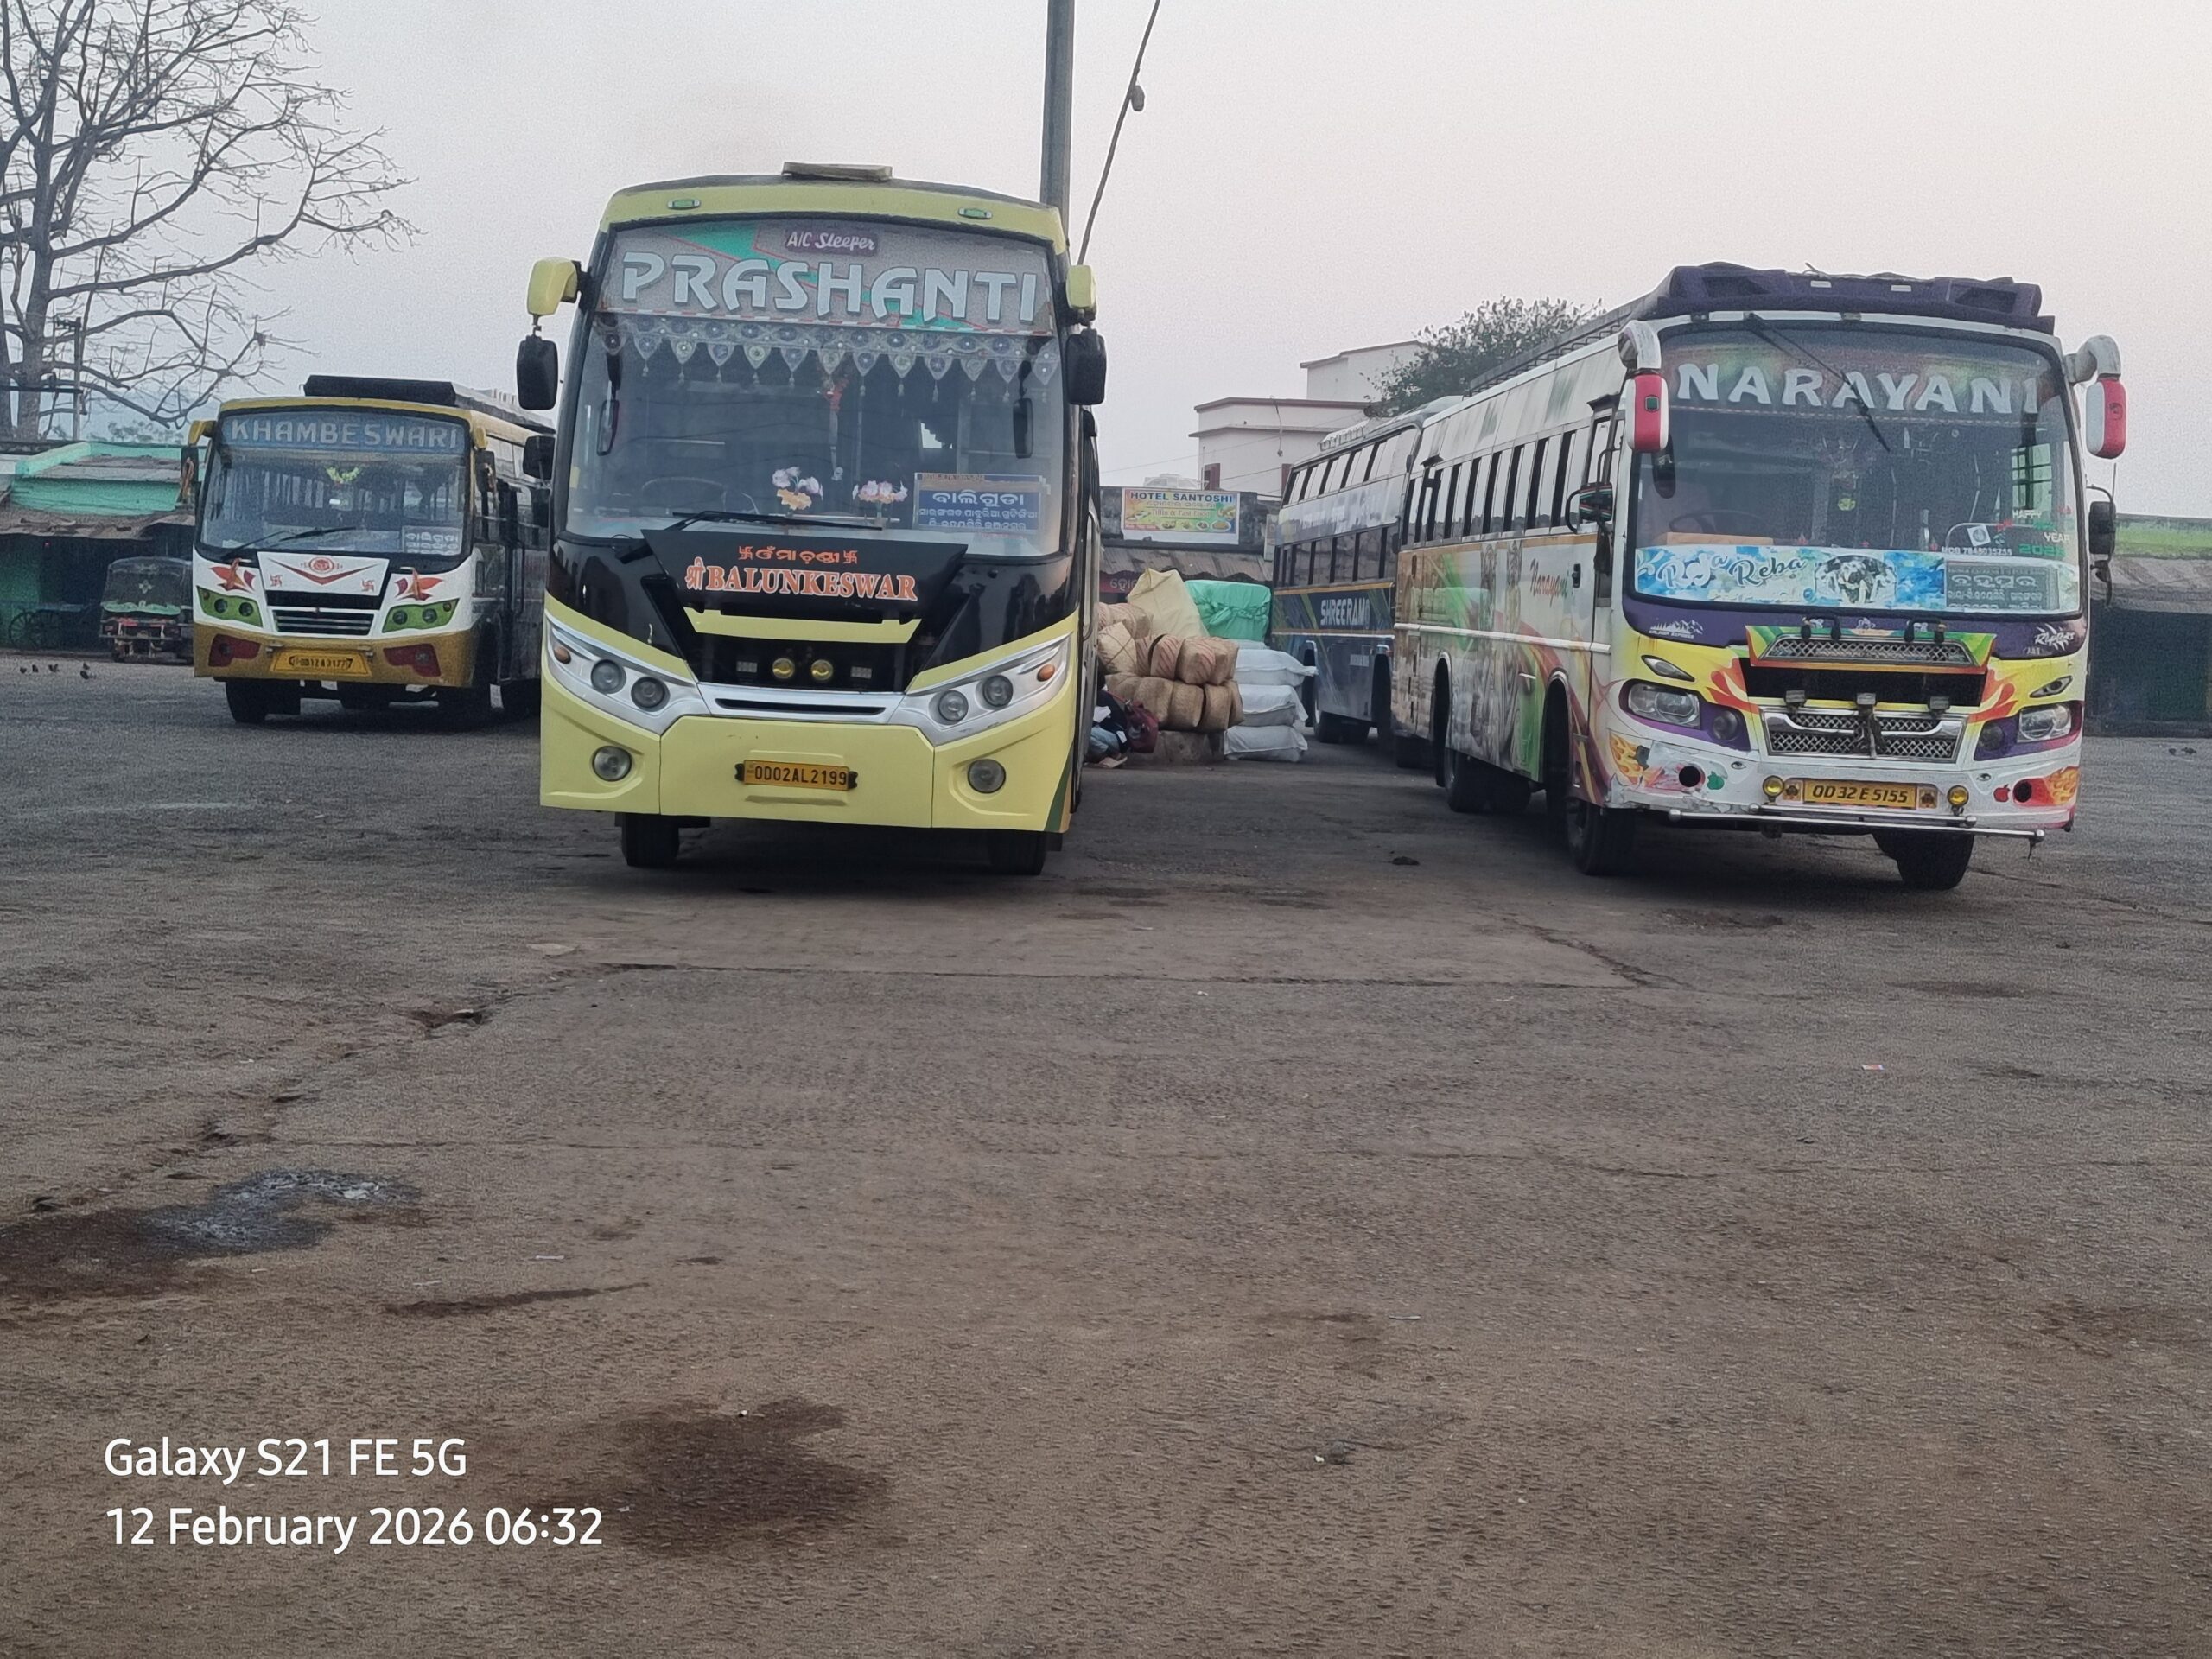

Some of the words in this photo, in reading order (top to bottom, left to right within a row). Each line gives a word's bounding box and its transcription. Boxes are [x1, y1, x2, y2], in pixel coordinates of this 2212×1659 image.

[786, 231, 812, 248] A/C
[815, 232, 876, 251] Sleeper
[622, 251, 1038, 324] PRASHANTI
[1676, 363, 2038, 414] NARAYANI
[231, 419, 457, 448] KHAMBESWARI
[1130, 492, 1169, 500] HOTEL
[1173, 493, 1233, 503] SANTOSHI
[2012, 509, 2043, 519] HAPPY
[2044, 531, 2071, 543] YEAR
[1729, 556, 1805, 588] Reba
[706, 565, 918, 601] BALUNKESWAR
[754, 766, 847, 785] OD02AL2199
[1812, 785, 1836, 798] OD
[1837, 786, 1858, 799] 32
[1859, 787, 1870, 800] E
[1871, 789, 1909, 803] 5155
